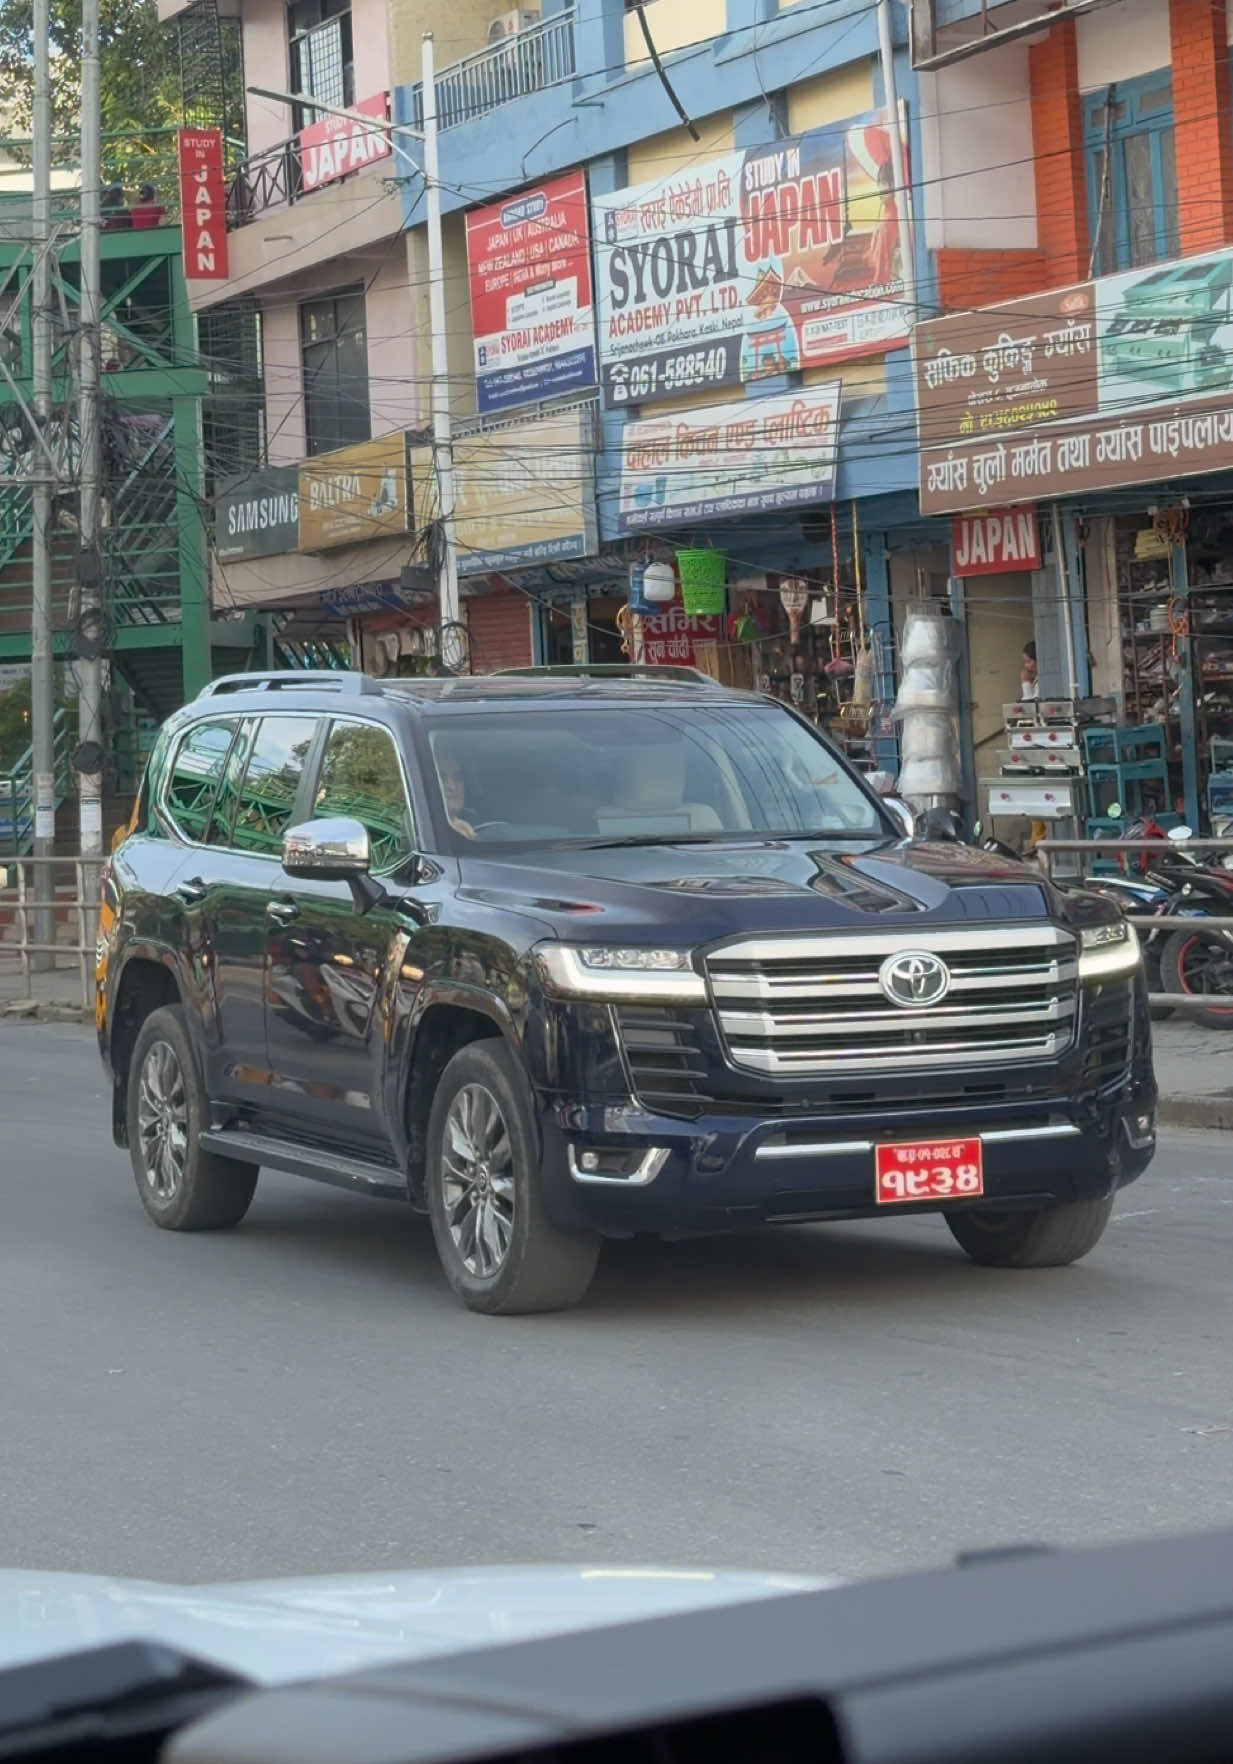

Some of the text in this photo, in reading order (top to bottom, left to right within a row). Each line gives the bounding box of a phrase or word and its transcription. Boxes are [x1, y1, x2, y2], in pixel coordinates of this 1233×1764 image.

[183, 138, 216, 149] STUDY
[195, 149, 206, 159] IN
[306, 114, 387, 187] JAPAN
[745, 146, 800, 192] STUDY IN
[194, 164, 216, 272] JAPAN
[743, 166, 844, 265] JAPAN
[486, 233, 509, 252] JAPAN
[609, 216, 740, 311] SYORAI
[500, 329, 531, 354] SYORAI
[532, 316, 574, 345] ACADEMY
[609, 302, 672, 338] ACADEMY
[676, 294, 707, 323] PVT.
[711, 285, 742, 314] LTD.
[721, 313, 744, 333] Nepal
[630, 346, 727, 398] 061-588540
[971, 443, 1007, 496] चुलो
[1056, 434, 1091, 474] तथा
[228, 492, 299, 536] SAMSUNG
[309, 471, 361, 512] BALTRA
[955, 512, 1036, 567] JAPAN
